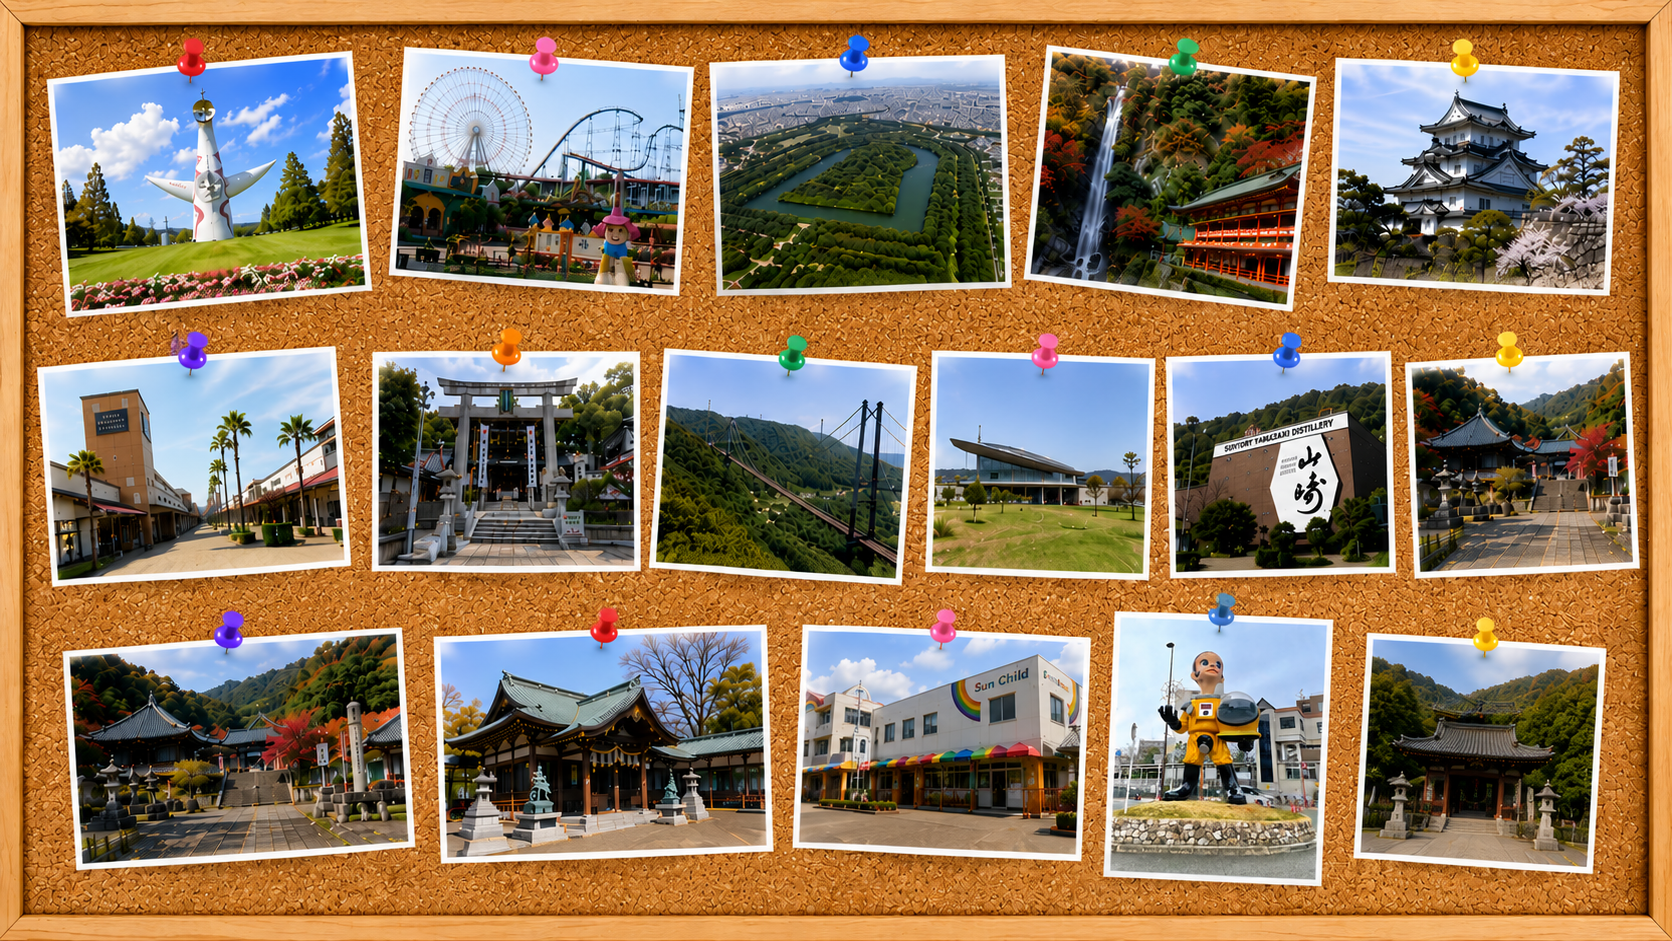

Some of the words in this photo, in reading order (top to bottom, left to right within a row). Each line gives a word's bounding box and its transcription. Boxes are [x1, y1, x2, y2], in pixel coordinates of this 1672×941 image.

[1292, 419, 1334, 436] DISTILLERY
[1294, 445, 1327, 514] 山崎
[975, 681, 995, 693] Sun
[998, 668, 1029, 686] Child
